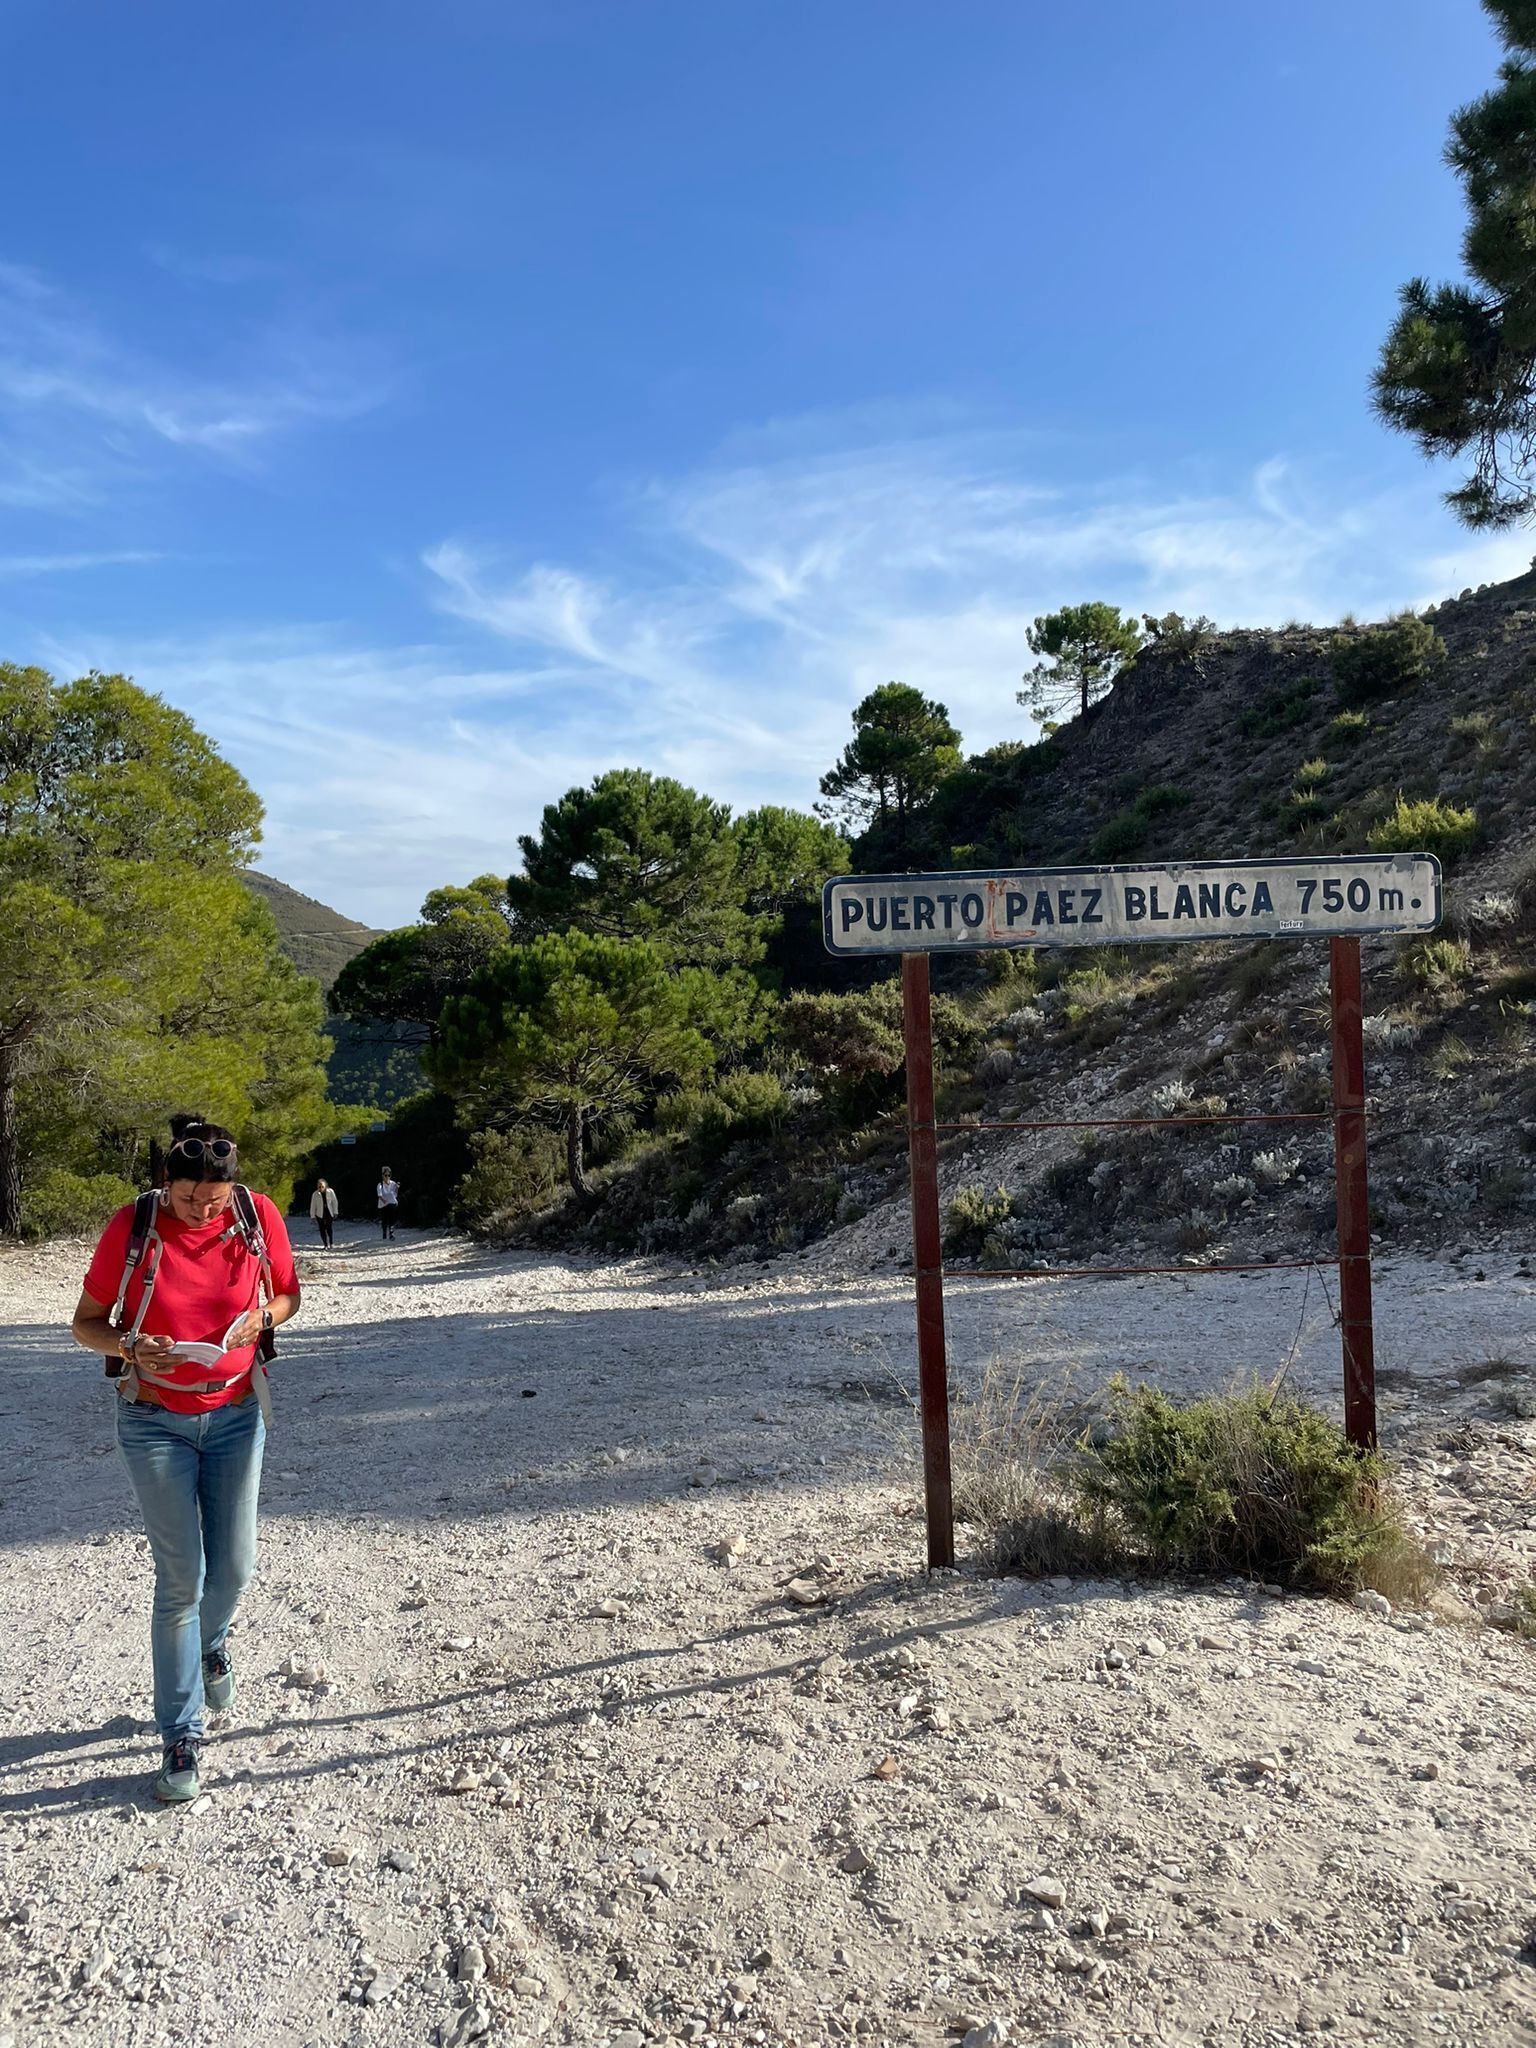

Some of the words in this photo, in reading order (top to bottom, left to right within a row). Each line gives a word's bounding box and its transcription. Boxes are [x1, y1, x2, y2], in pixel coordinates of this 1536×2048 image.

[841, 893, 984, 932] PUERTO
[1006, 888, 1103, 925] PAEZ
[1124, 881, 1273, 921] BLANCA
[1296, 878, 1371, 914] 750
